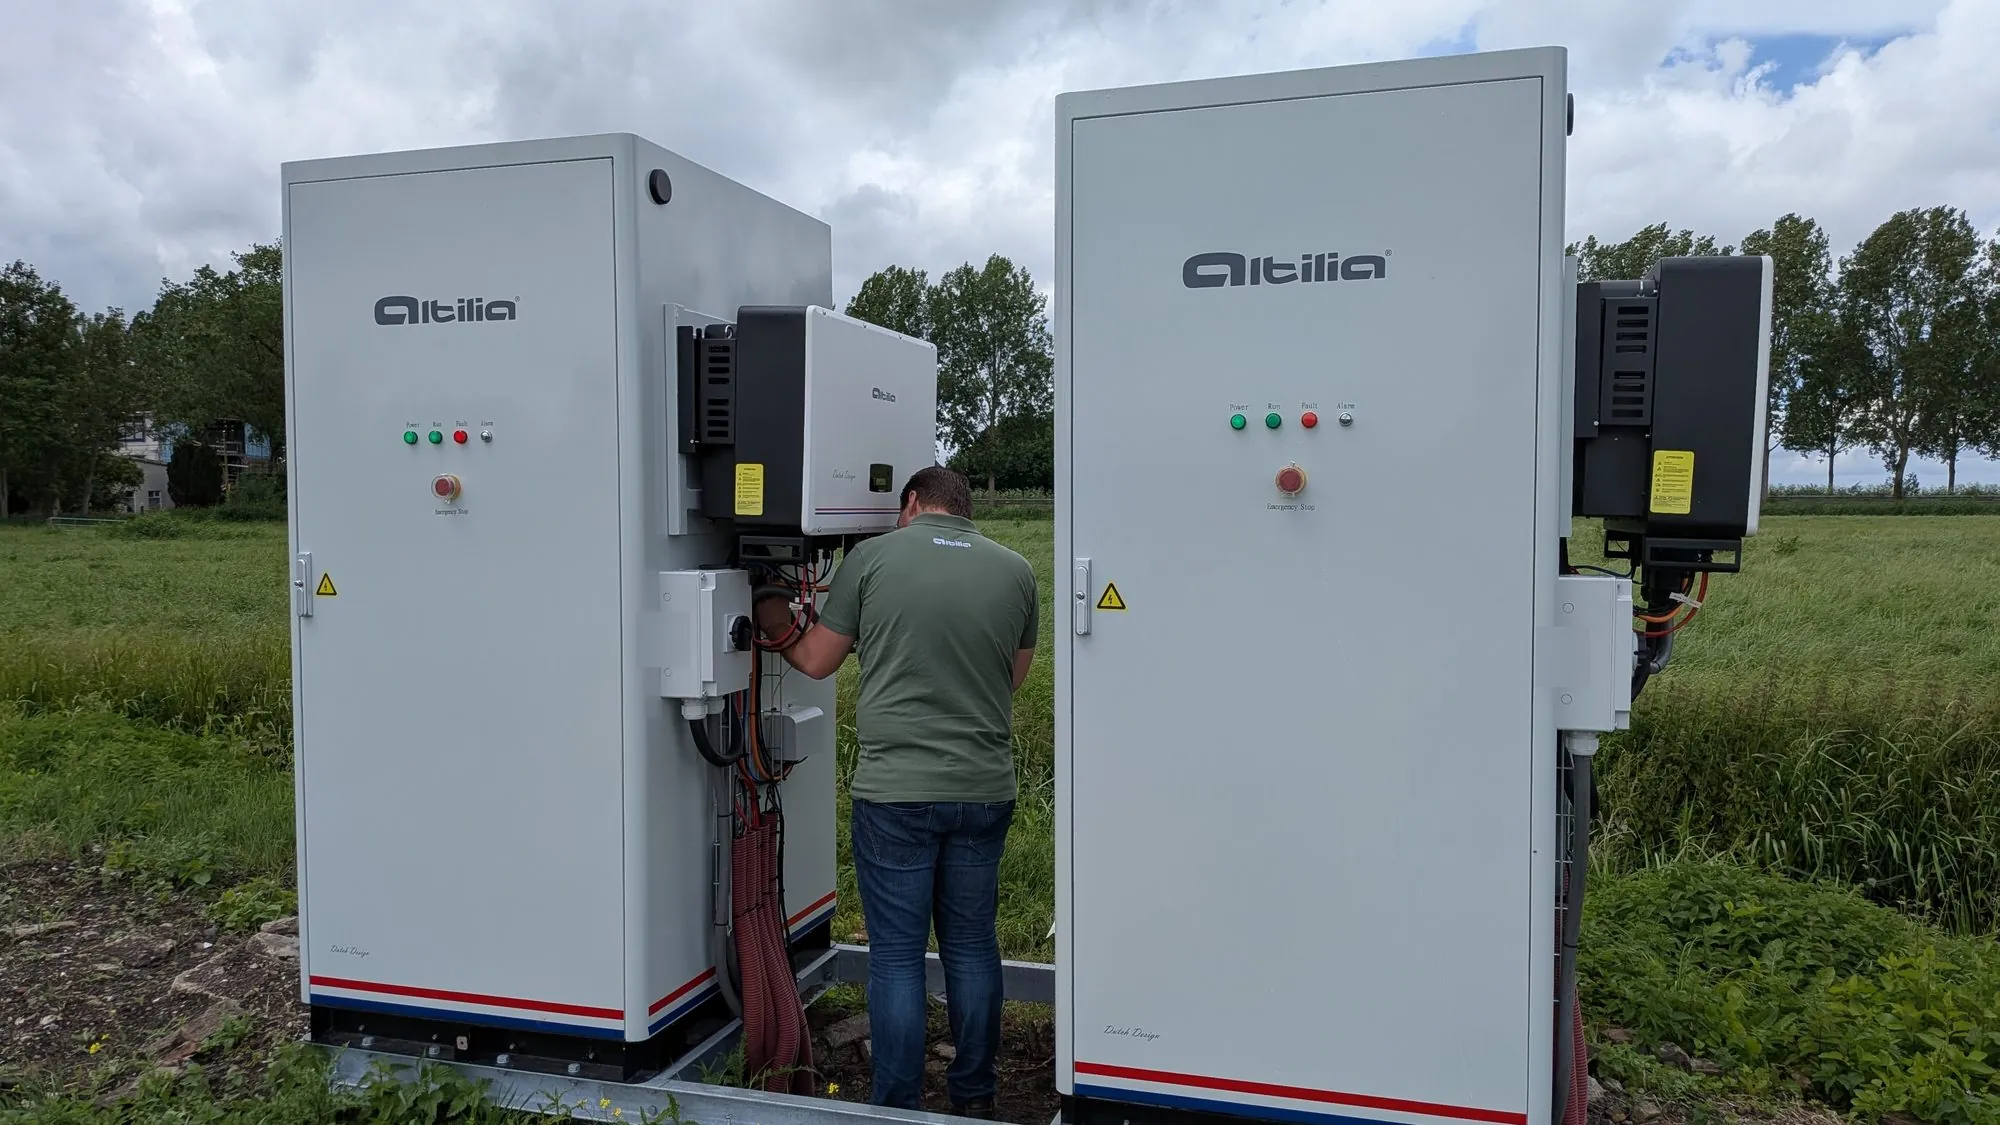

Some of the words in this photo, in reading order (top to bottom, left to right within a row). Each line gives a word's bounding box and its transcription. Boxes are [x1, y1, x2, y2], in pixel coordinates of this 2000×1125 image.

[1229, 403, 1248, 412] Power
[1267, 402, 1281, 410] Run
[1301, 402, 1318, 410] Fault
[1336, 402, 1355, 410] Alarm
[1300, 503, 1316, 511] Stop
[1104, 1025, 1130, 1036] Dutch
